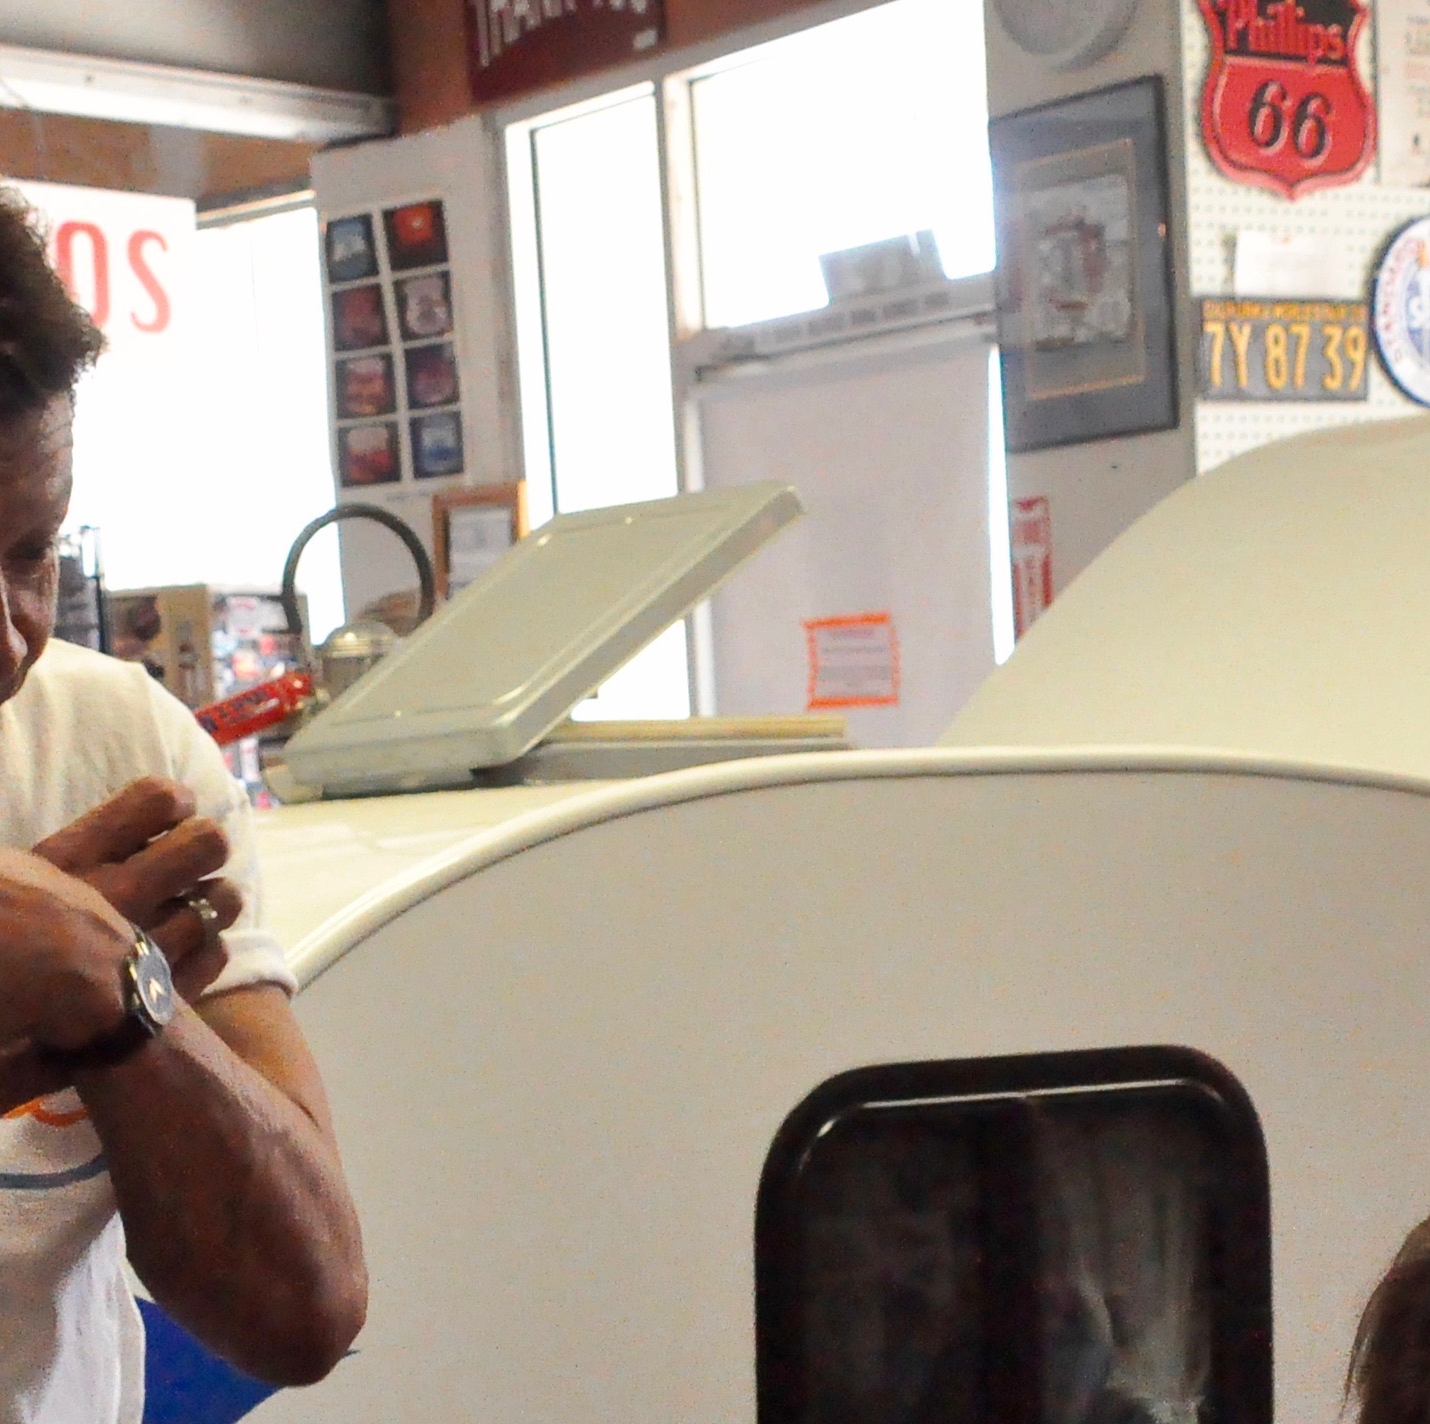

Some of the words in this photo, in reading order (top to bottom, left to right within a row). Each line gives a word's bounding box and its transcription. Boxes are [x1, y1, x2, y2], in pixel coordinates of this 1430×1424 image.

[1220, 0, 1345, 64] Phillips
[1249, 79, 1335, 164] 66
[1203, 321, 1252, 389] 7Y
[1265, 323, 1311, 390] 87
[1322, 324, 1367, 392] 39
